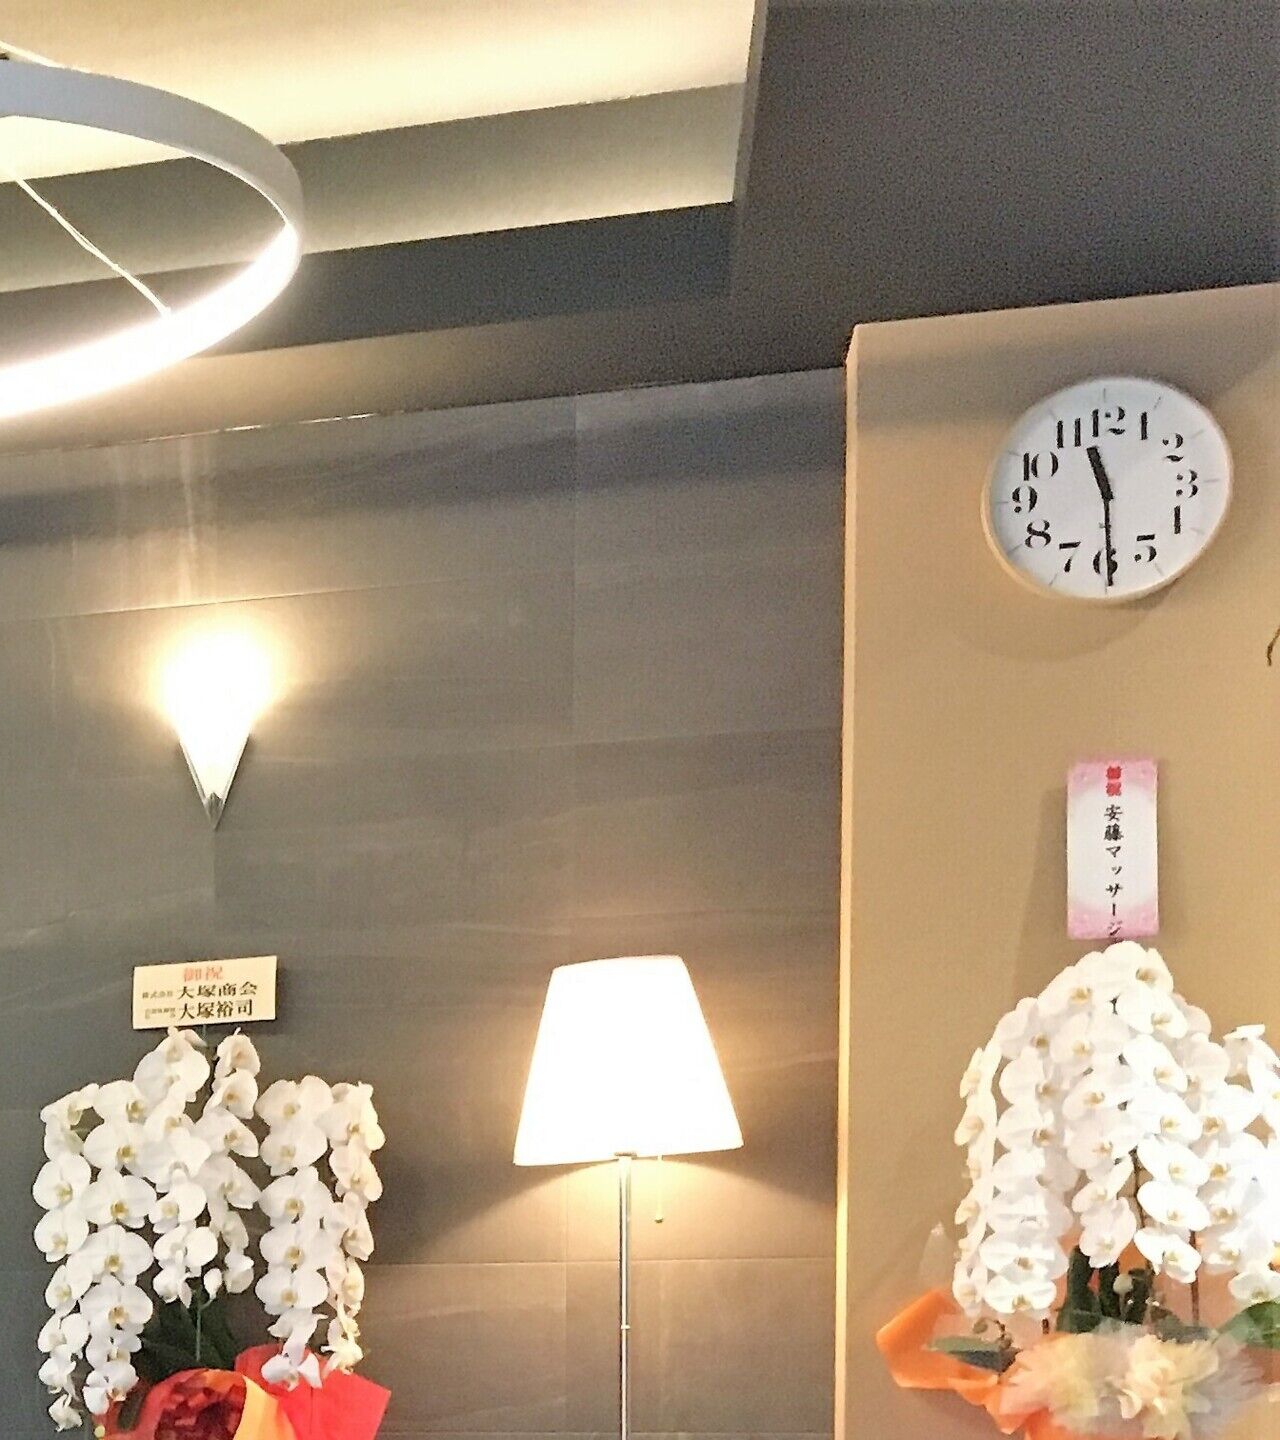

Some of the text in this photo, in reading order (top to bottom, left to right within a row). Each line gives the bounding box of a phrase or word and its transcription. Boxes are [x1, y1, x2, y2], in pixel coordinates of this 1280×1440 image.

[1056, 418, 1082, 449] 11
[1092, 406, 1126, 438] 12
[1139, 410, 1148, 441] 1
[1161, 432, 1184, 463] 2
[1022, 451, 1059, 482] 10
[1011, 485, 1038, 513] 9
[1175, 468, 1199, 499] 3
[1024, 518, 1052, 549] 8
[1133, 533, 1158, 563] 5
[1058, 541, 1082, 573] 7
[1092, 547, 1118, 576] 6
